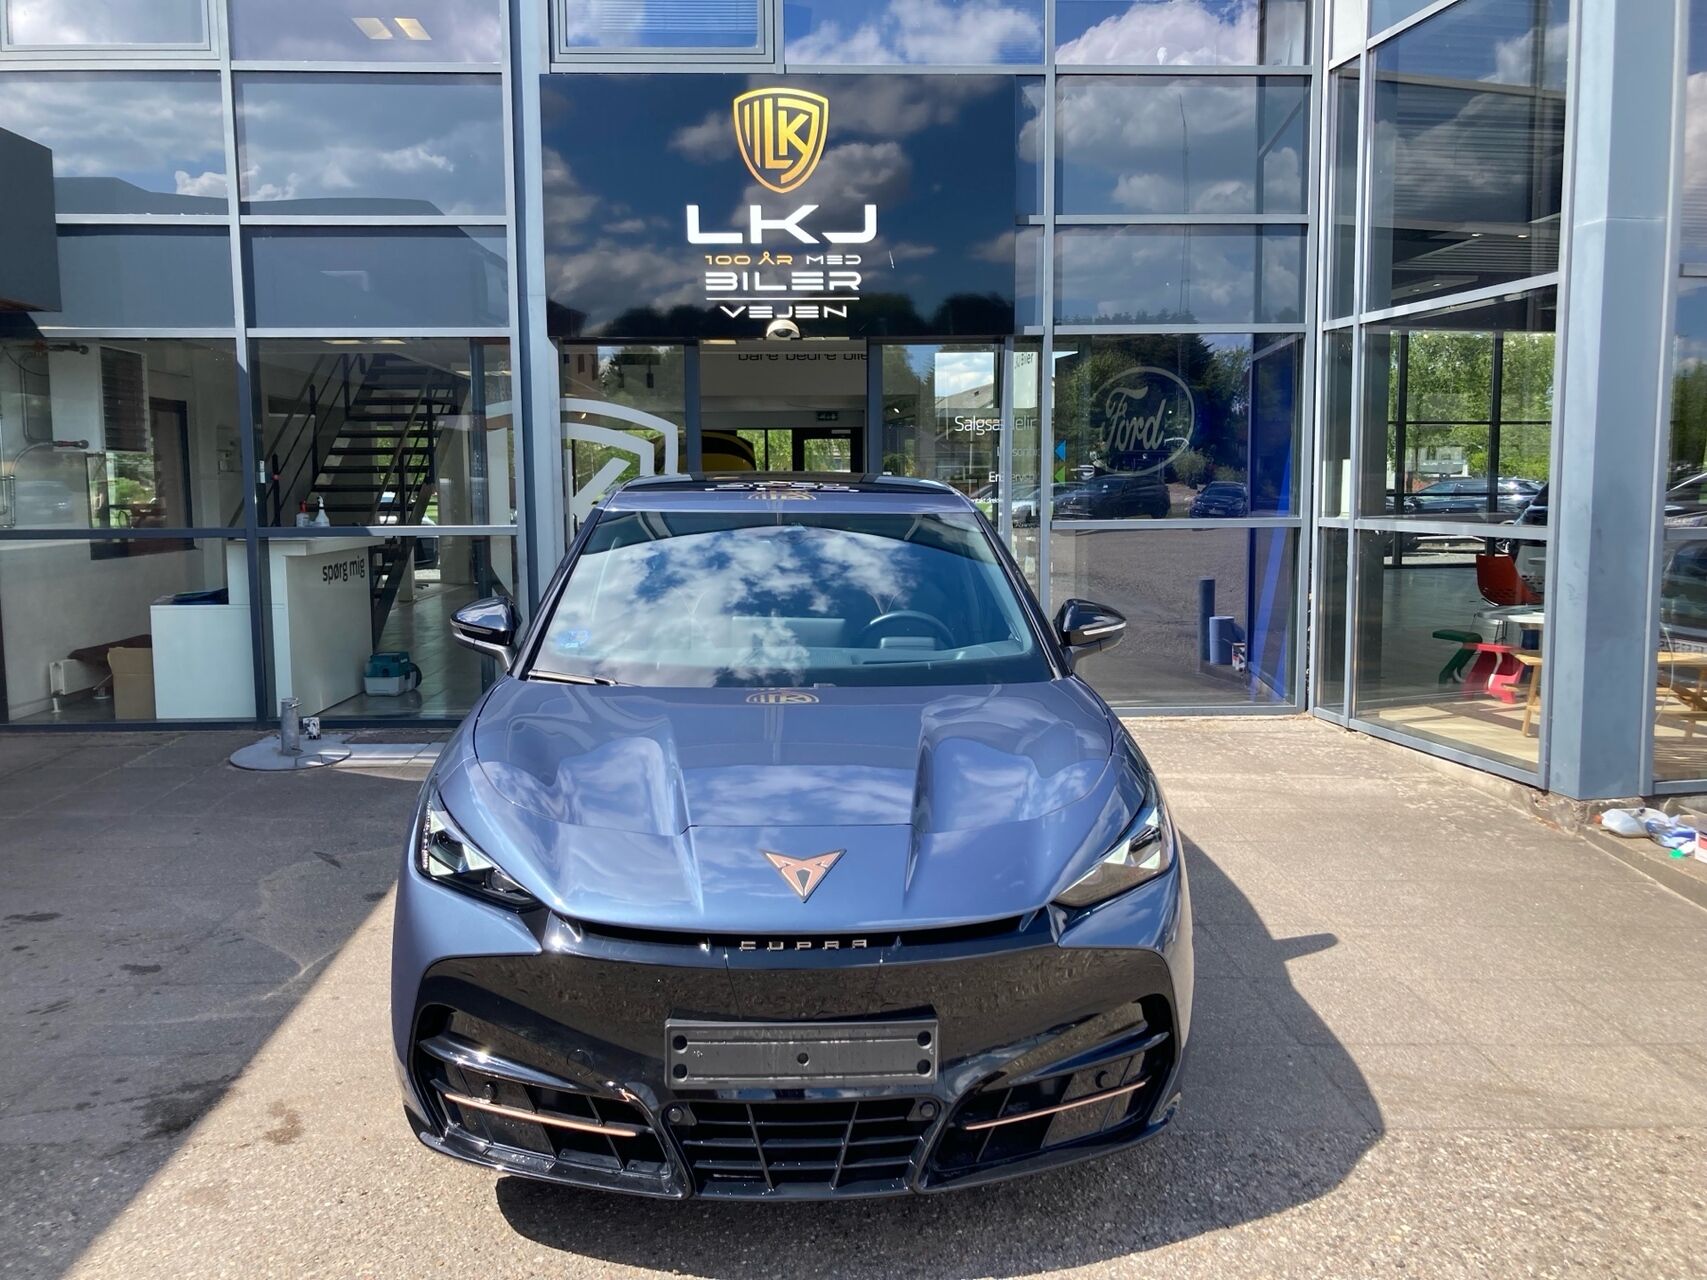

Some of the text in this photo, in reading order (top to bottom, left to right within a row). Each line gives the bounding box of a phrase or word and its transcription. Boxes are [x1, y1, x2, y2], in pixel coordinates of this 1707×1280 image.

[686, 204, 877, 244] LKJ
[705, 251, 862, 265] 100 ÅR MED
[705, 271, 862, 291] BILER
[719, 305, 848, 319] VEJEN
[1102, 386, 1166, 451] Ford
[322, 554, 365, 585] spørg mig
[740, 939, 867, 951] CUPRA
